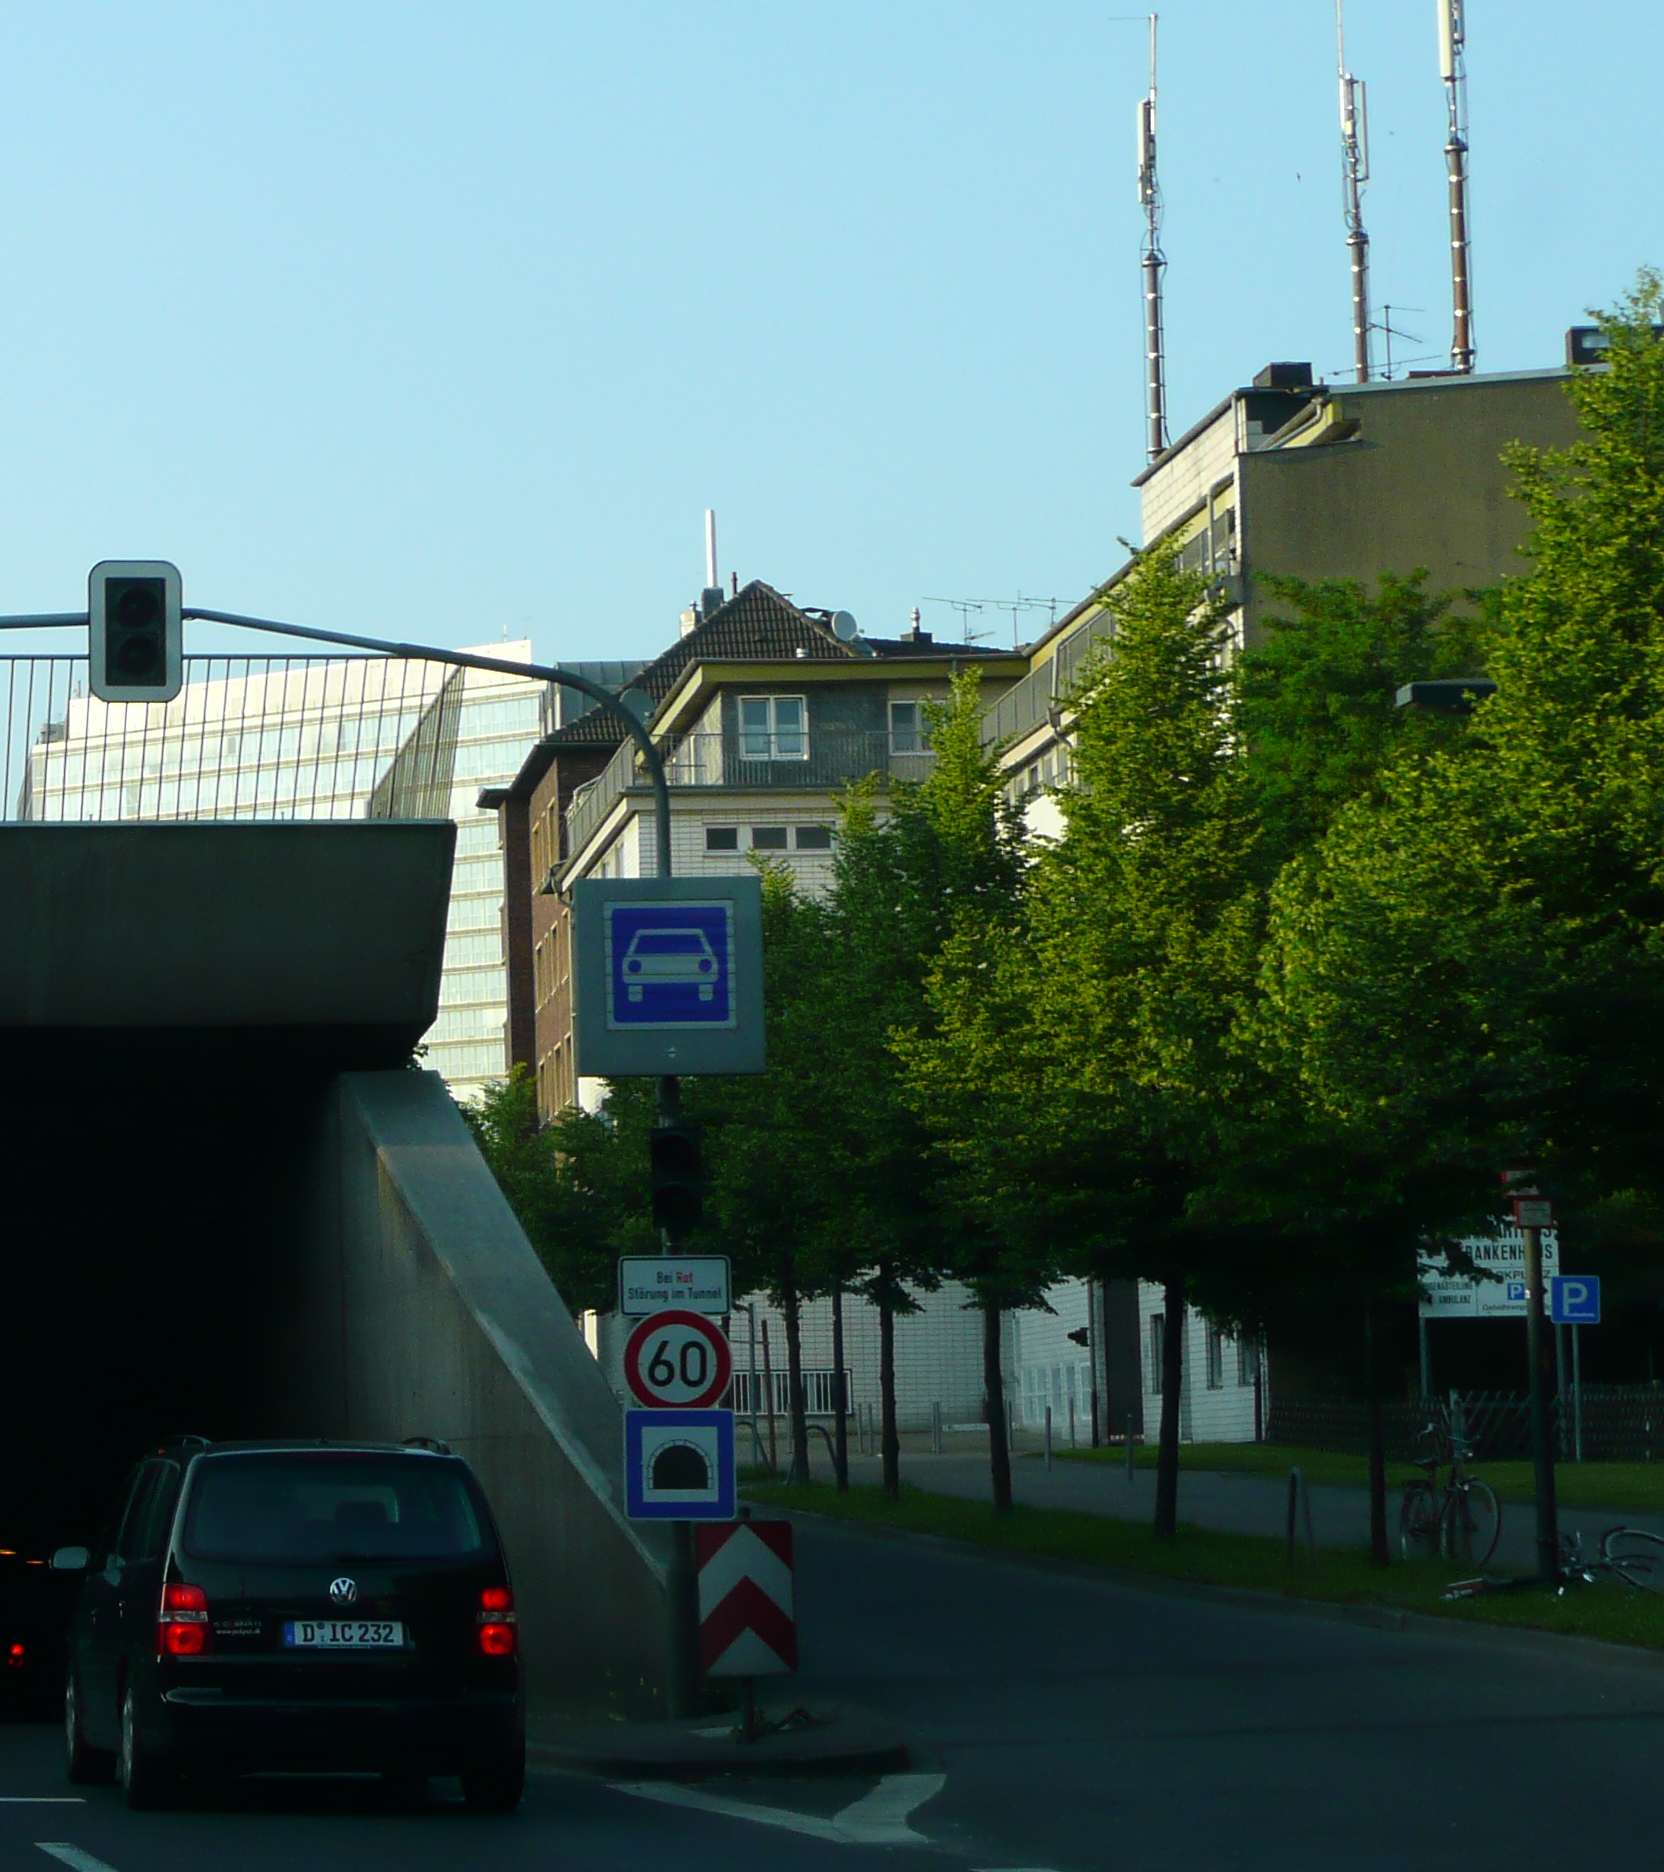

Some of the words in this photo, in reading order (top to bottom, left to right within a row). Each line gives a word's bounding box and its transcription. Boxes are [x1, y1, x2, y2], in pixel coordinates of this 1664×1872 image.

[1466, 1244, 1553, 1260] RANKENHS
[656, 1271, 673, 1284] Bei
[676, 1271, 694, 1284] Rot
[628, 1286, 669, 1302] Störung
[671, 1287, 685, 1299] im
[688, 1286, 722, 1299] Tunnel
[1563, 1282, 1588, 1316] P
[648, 1340, 708, 1388] 60
[302, 1624, 315, 1642] D
[330, 1624, 353, 1642] IC
[359, 1624, 394, 1642] 232
